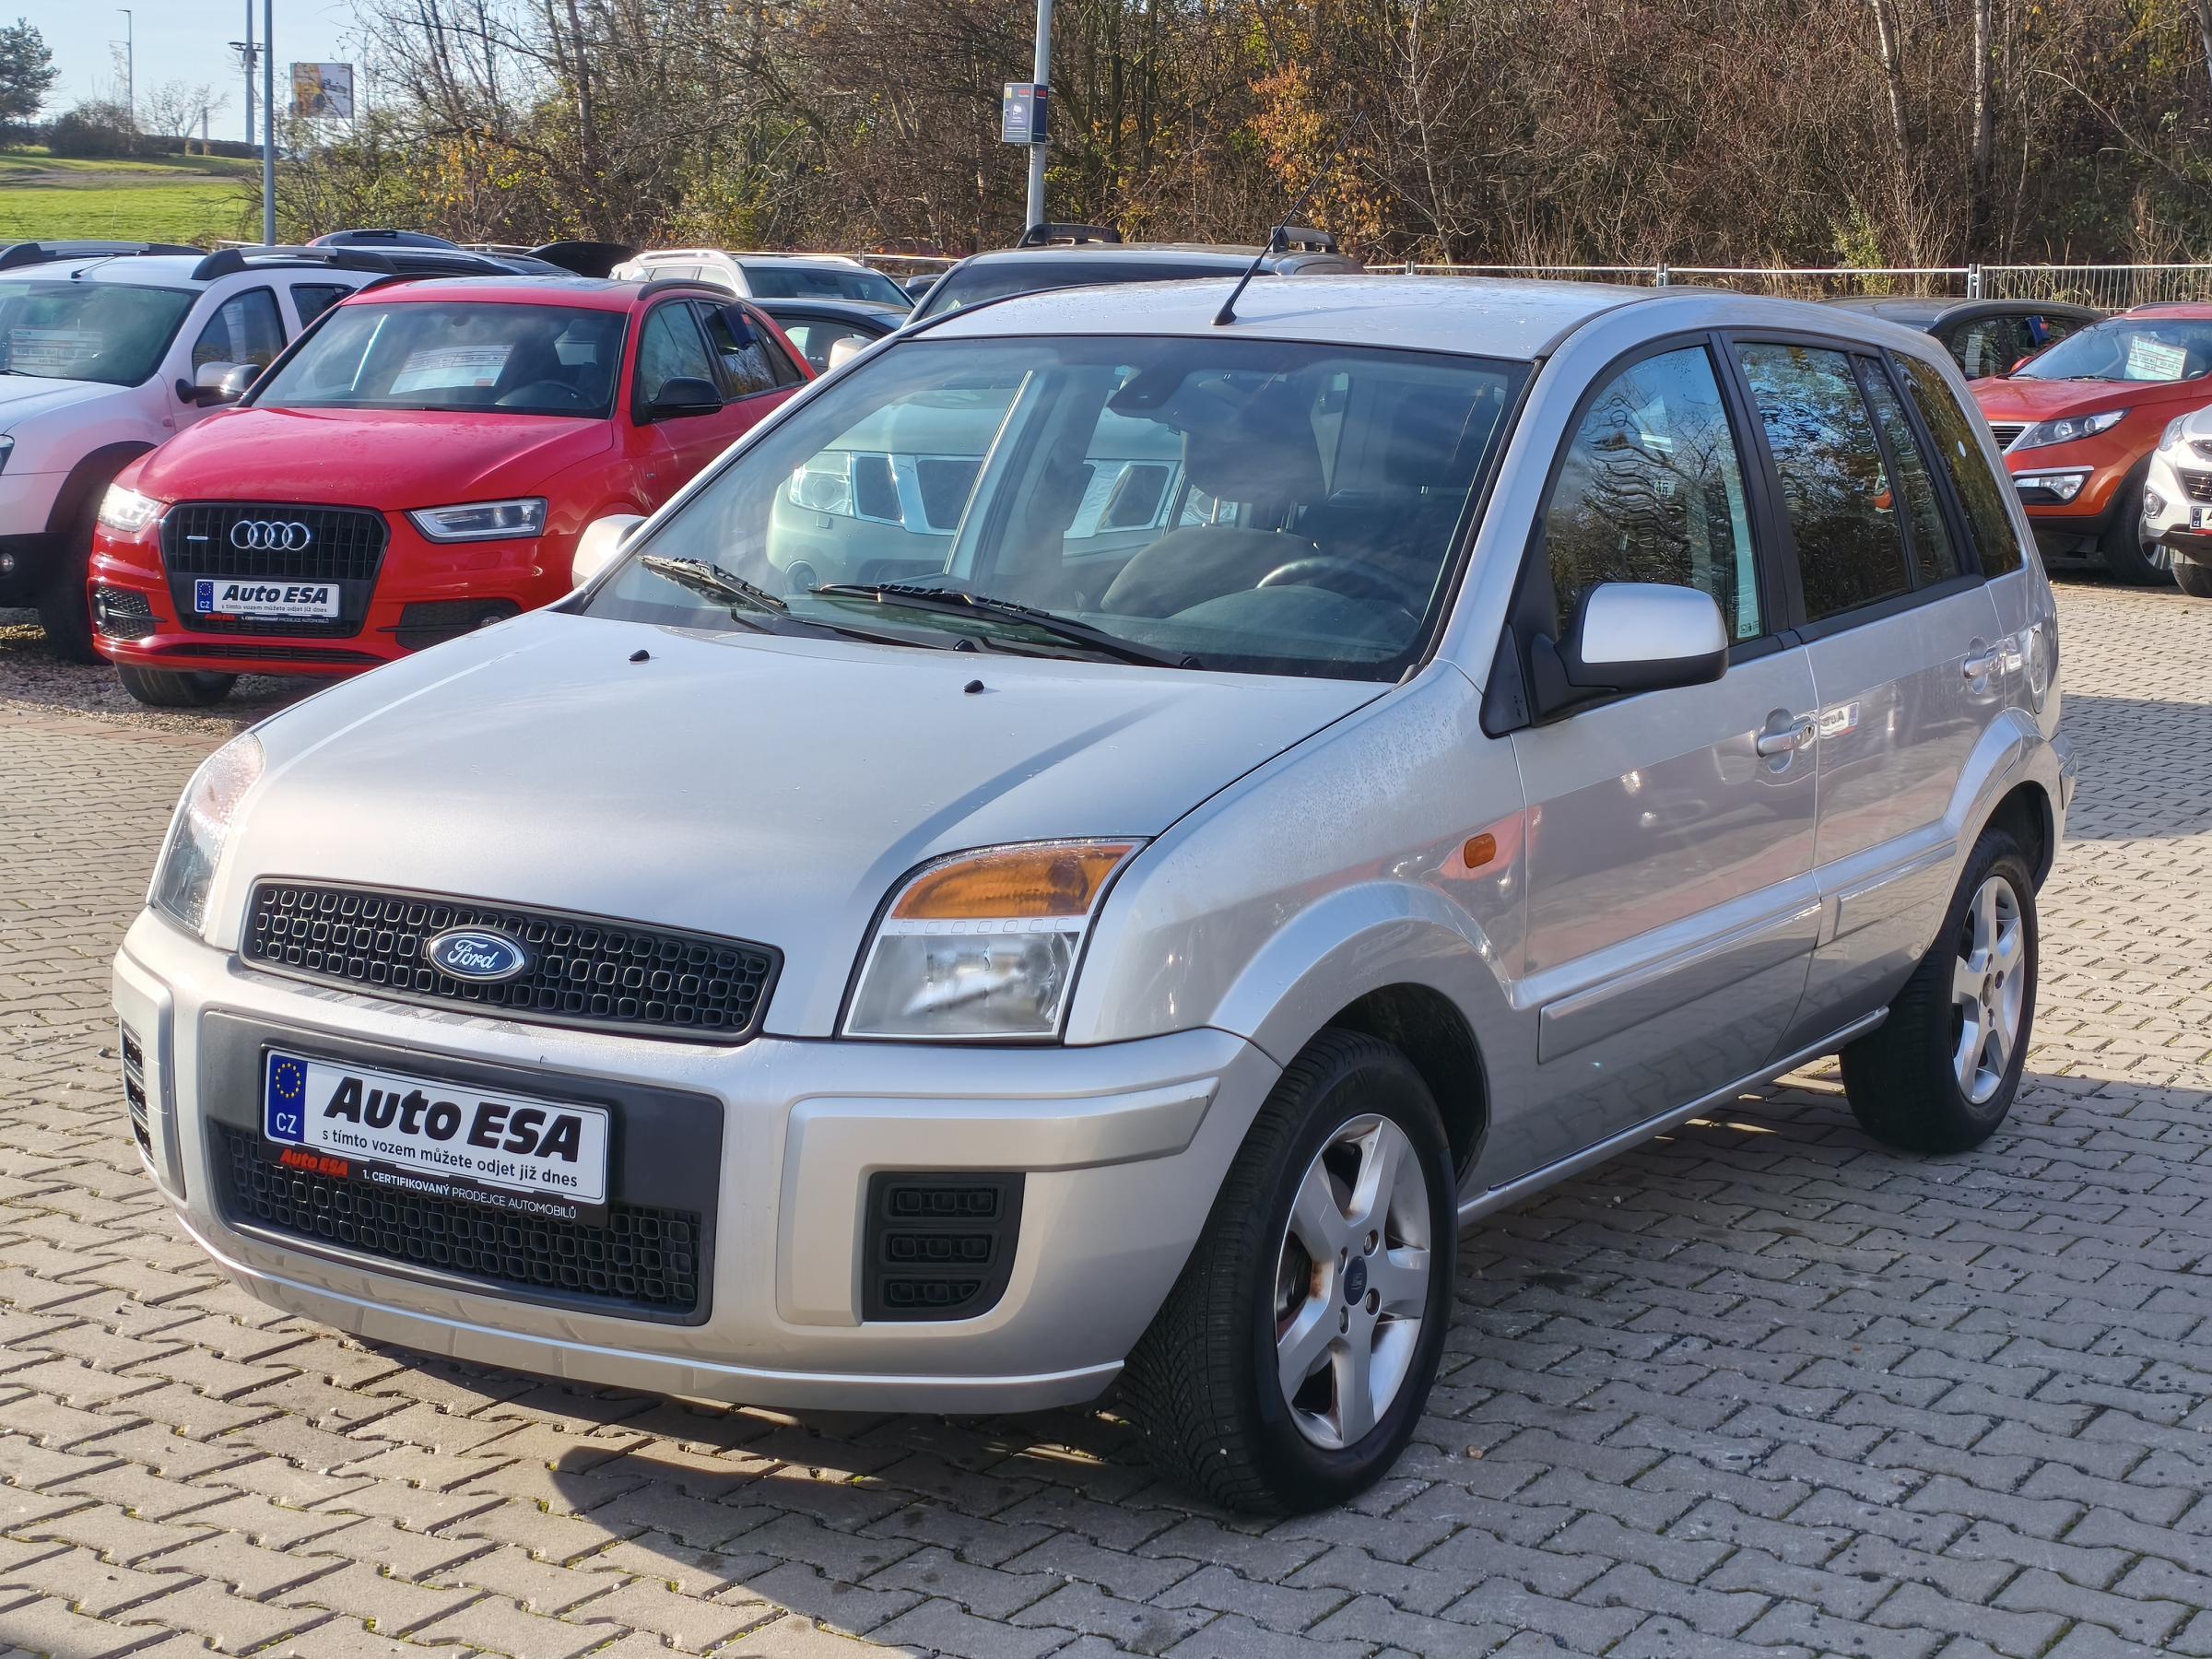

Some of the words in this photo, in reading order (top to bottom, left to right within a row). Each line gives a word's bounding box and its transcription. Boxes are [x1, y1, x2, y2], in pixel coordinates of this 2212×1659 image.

[199, 601, 210, 609] CZ
[222, 585, 281, 603] Auto
[283, 587, 329, 604] ESA
[447, 939, 500, 969] Ford
[276, 1112, 298, 1135] CZ
[323, 1076, 462, 1142] Auto
[466, 1101, 582, 1163] ESA
[280, 1148, 318, 1169] Auto
[318, 1156, 348, 1178] ESA
[323, 1130, 329, 1140] s
[333, 1131, 368, 1148] tímto
[371, 1139, 416, 1159] vozem
[420, 1147, 473, 1169] můžete
[477, 1159, 515, 1177] odjet
[519, 1164, 537, 1182] již
[541, 1169, 578, 1187] dnes
[362, 1169, 370, 1180] 1.
[371, 1171, 450, 1195] CERTIFIKOVANÝ
[452, 1186, 506, 1207] PRODEJCE
[508, 1197, 577, 1219] AUTOMOBILŮ
